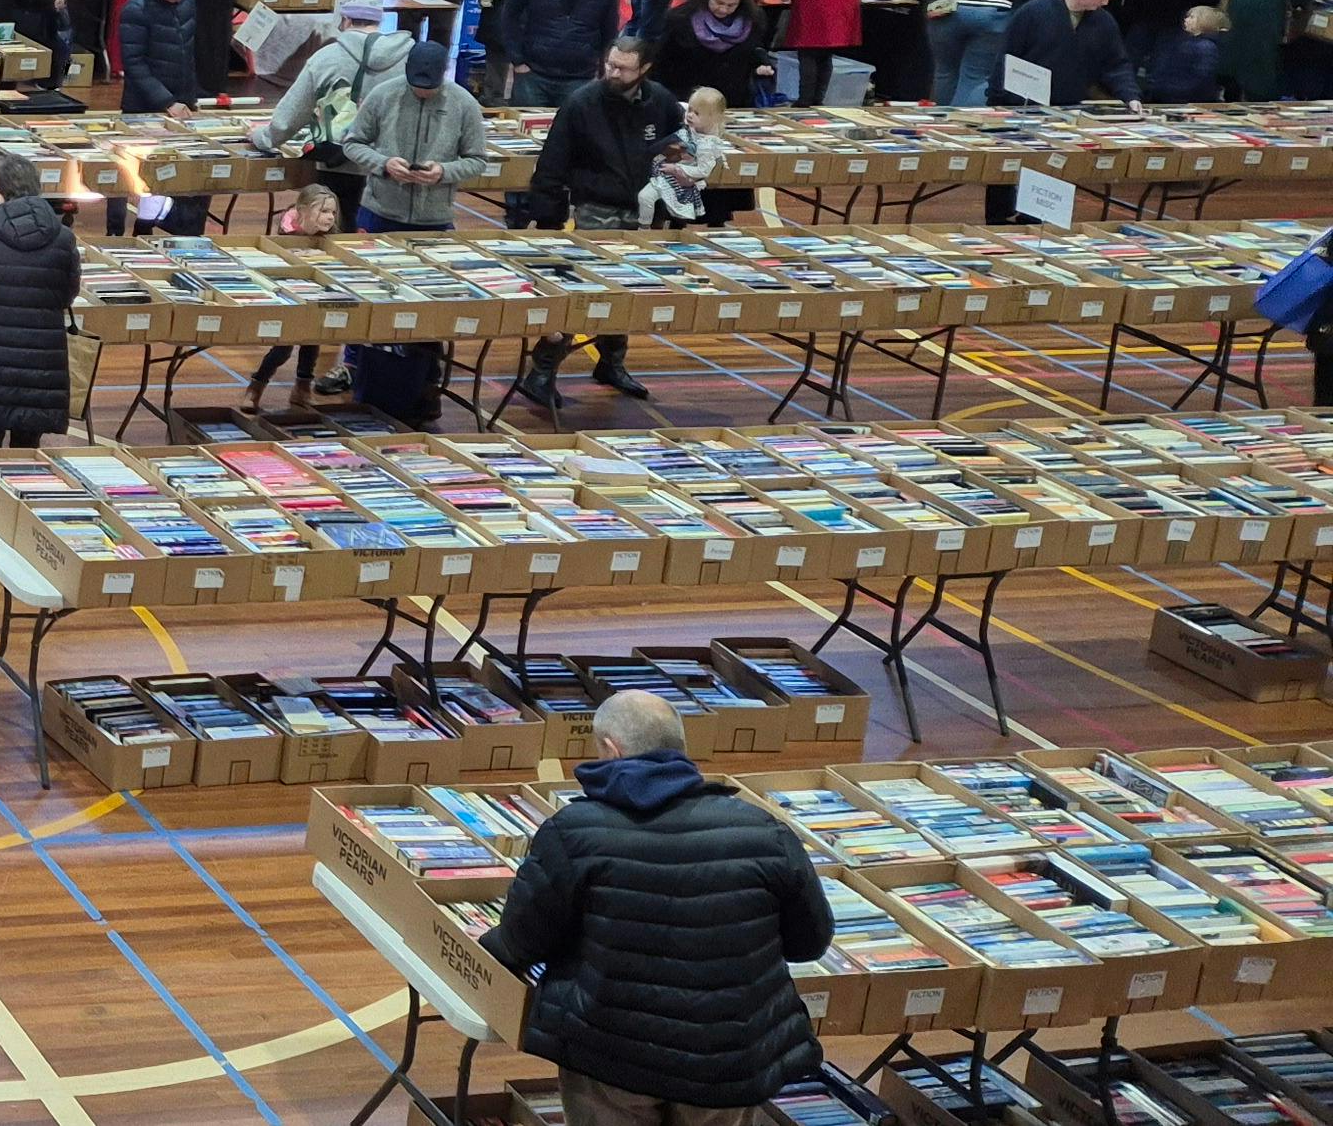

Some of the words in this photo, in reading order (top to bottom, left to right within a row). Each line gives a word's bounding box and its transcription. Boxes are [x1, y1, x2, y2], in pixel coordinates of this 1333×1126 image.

[1031, 185, 1062, 203] FICTION
[562, 712, 594, 722] VICTO
[570, 725, 594, 735] PEA
[333, 824, 388, 883] VICTORIAN
[339, 848, 376, 887] PEARS
[433, 922, 493, 986] VICTORIAN
[440, 944, 480, 991] PEARS
[911, 989, 942, 999] FICTION
